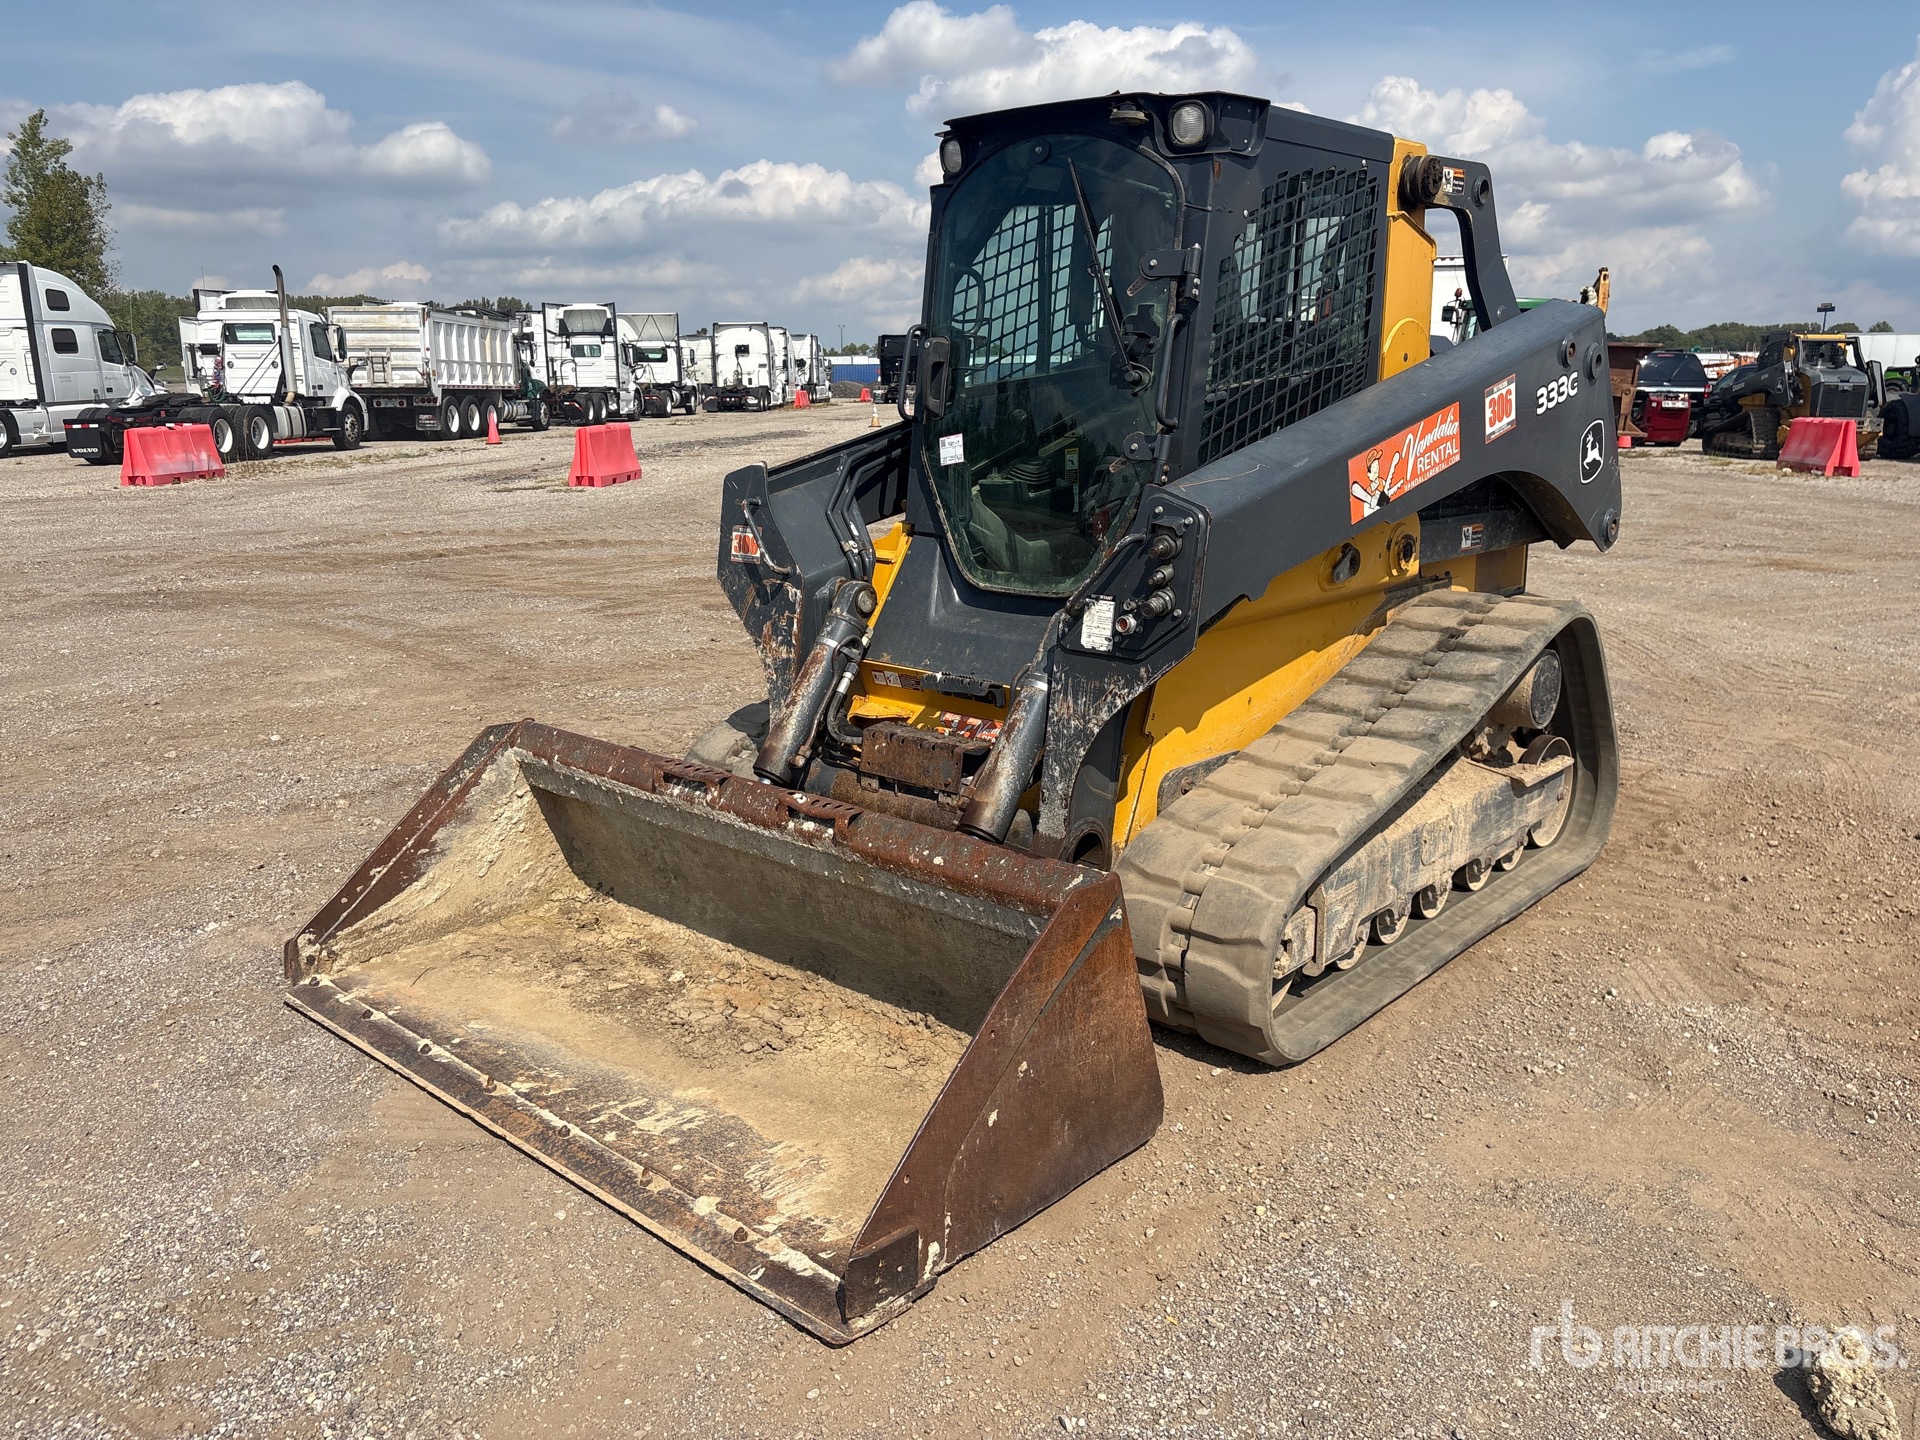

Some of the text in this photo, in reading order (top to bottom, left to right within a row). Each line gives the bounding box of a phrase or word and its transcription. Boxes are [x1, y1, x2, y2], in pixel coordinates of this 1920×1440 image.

[1489, 388, 1513, 428] 306
[1536, 370, 1578, 416] 333G
[71, 447, 99, 455] VOLVO
[1401, 406, 1459, 481] Vandalia
[1416, 438, 1459, 475] RENTAL
[1403, 454, 1460, 491] VANDALIARENTAL.COM
